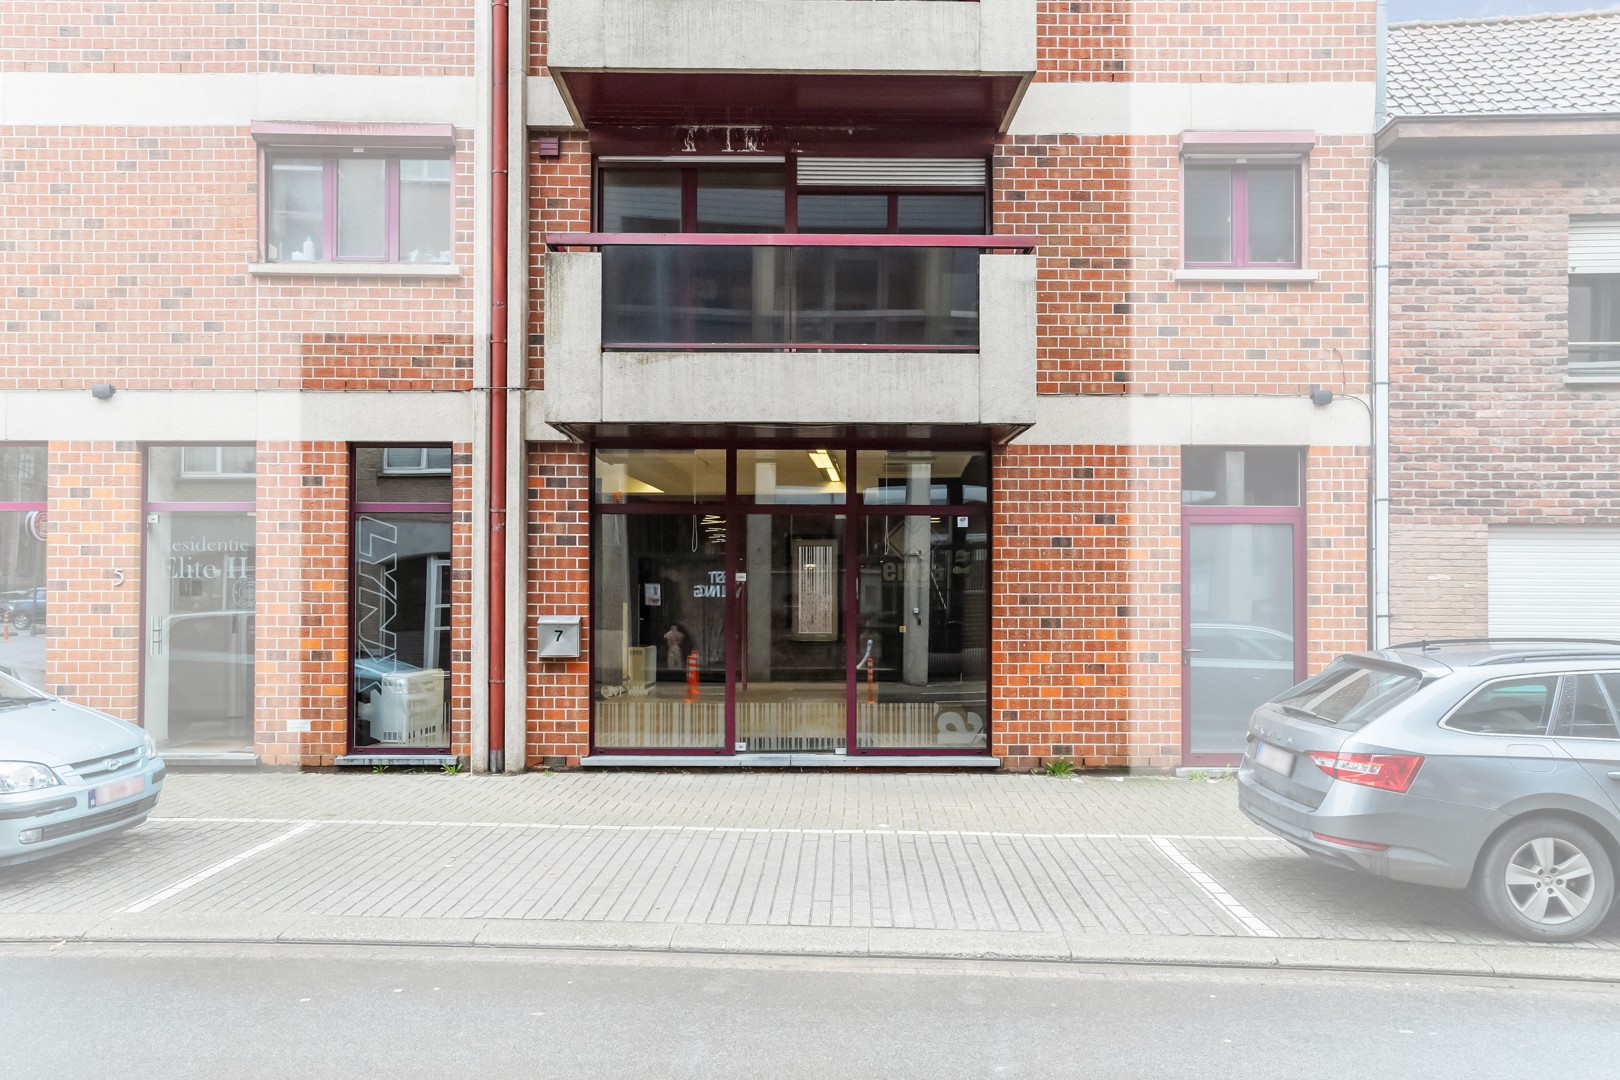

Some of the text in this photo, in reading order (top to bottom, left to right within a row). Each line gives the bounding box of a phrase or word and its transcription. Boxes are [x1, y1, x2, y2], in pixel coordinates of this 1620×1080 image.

[160, 556, 217, 579] Elite
[113, 568, 125, 587] 5
[554, 630, 564, 642] 7
